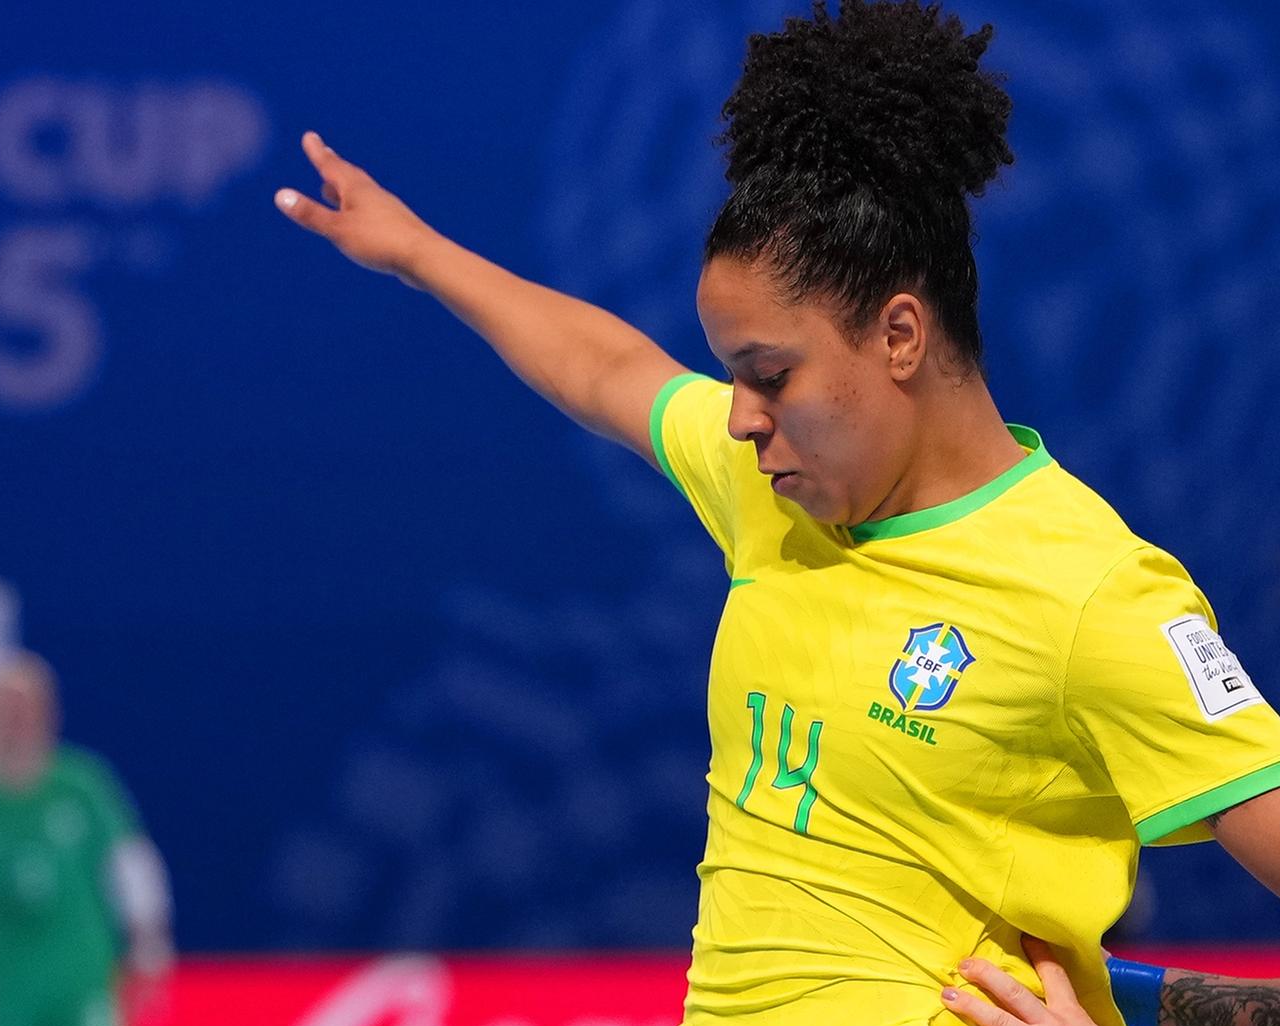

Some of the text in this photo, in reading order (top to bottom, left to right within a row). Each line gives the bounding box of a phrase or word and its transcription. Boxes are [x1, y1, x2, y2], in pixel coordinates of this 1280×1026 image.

[916, 655, 942, 673] CBF
[868, 702, 937, 745] BRASIL
[736, 691, 823, 835] 14
